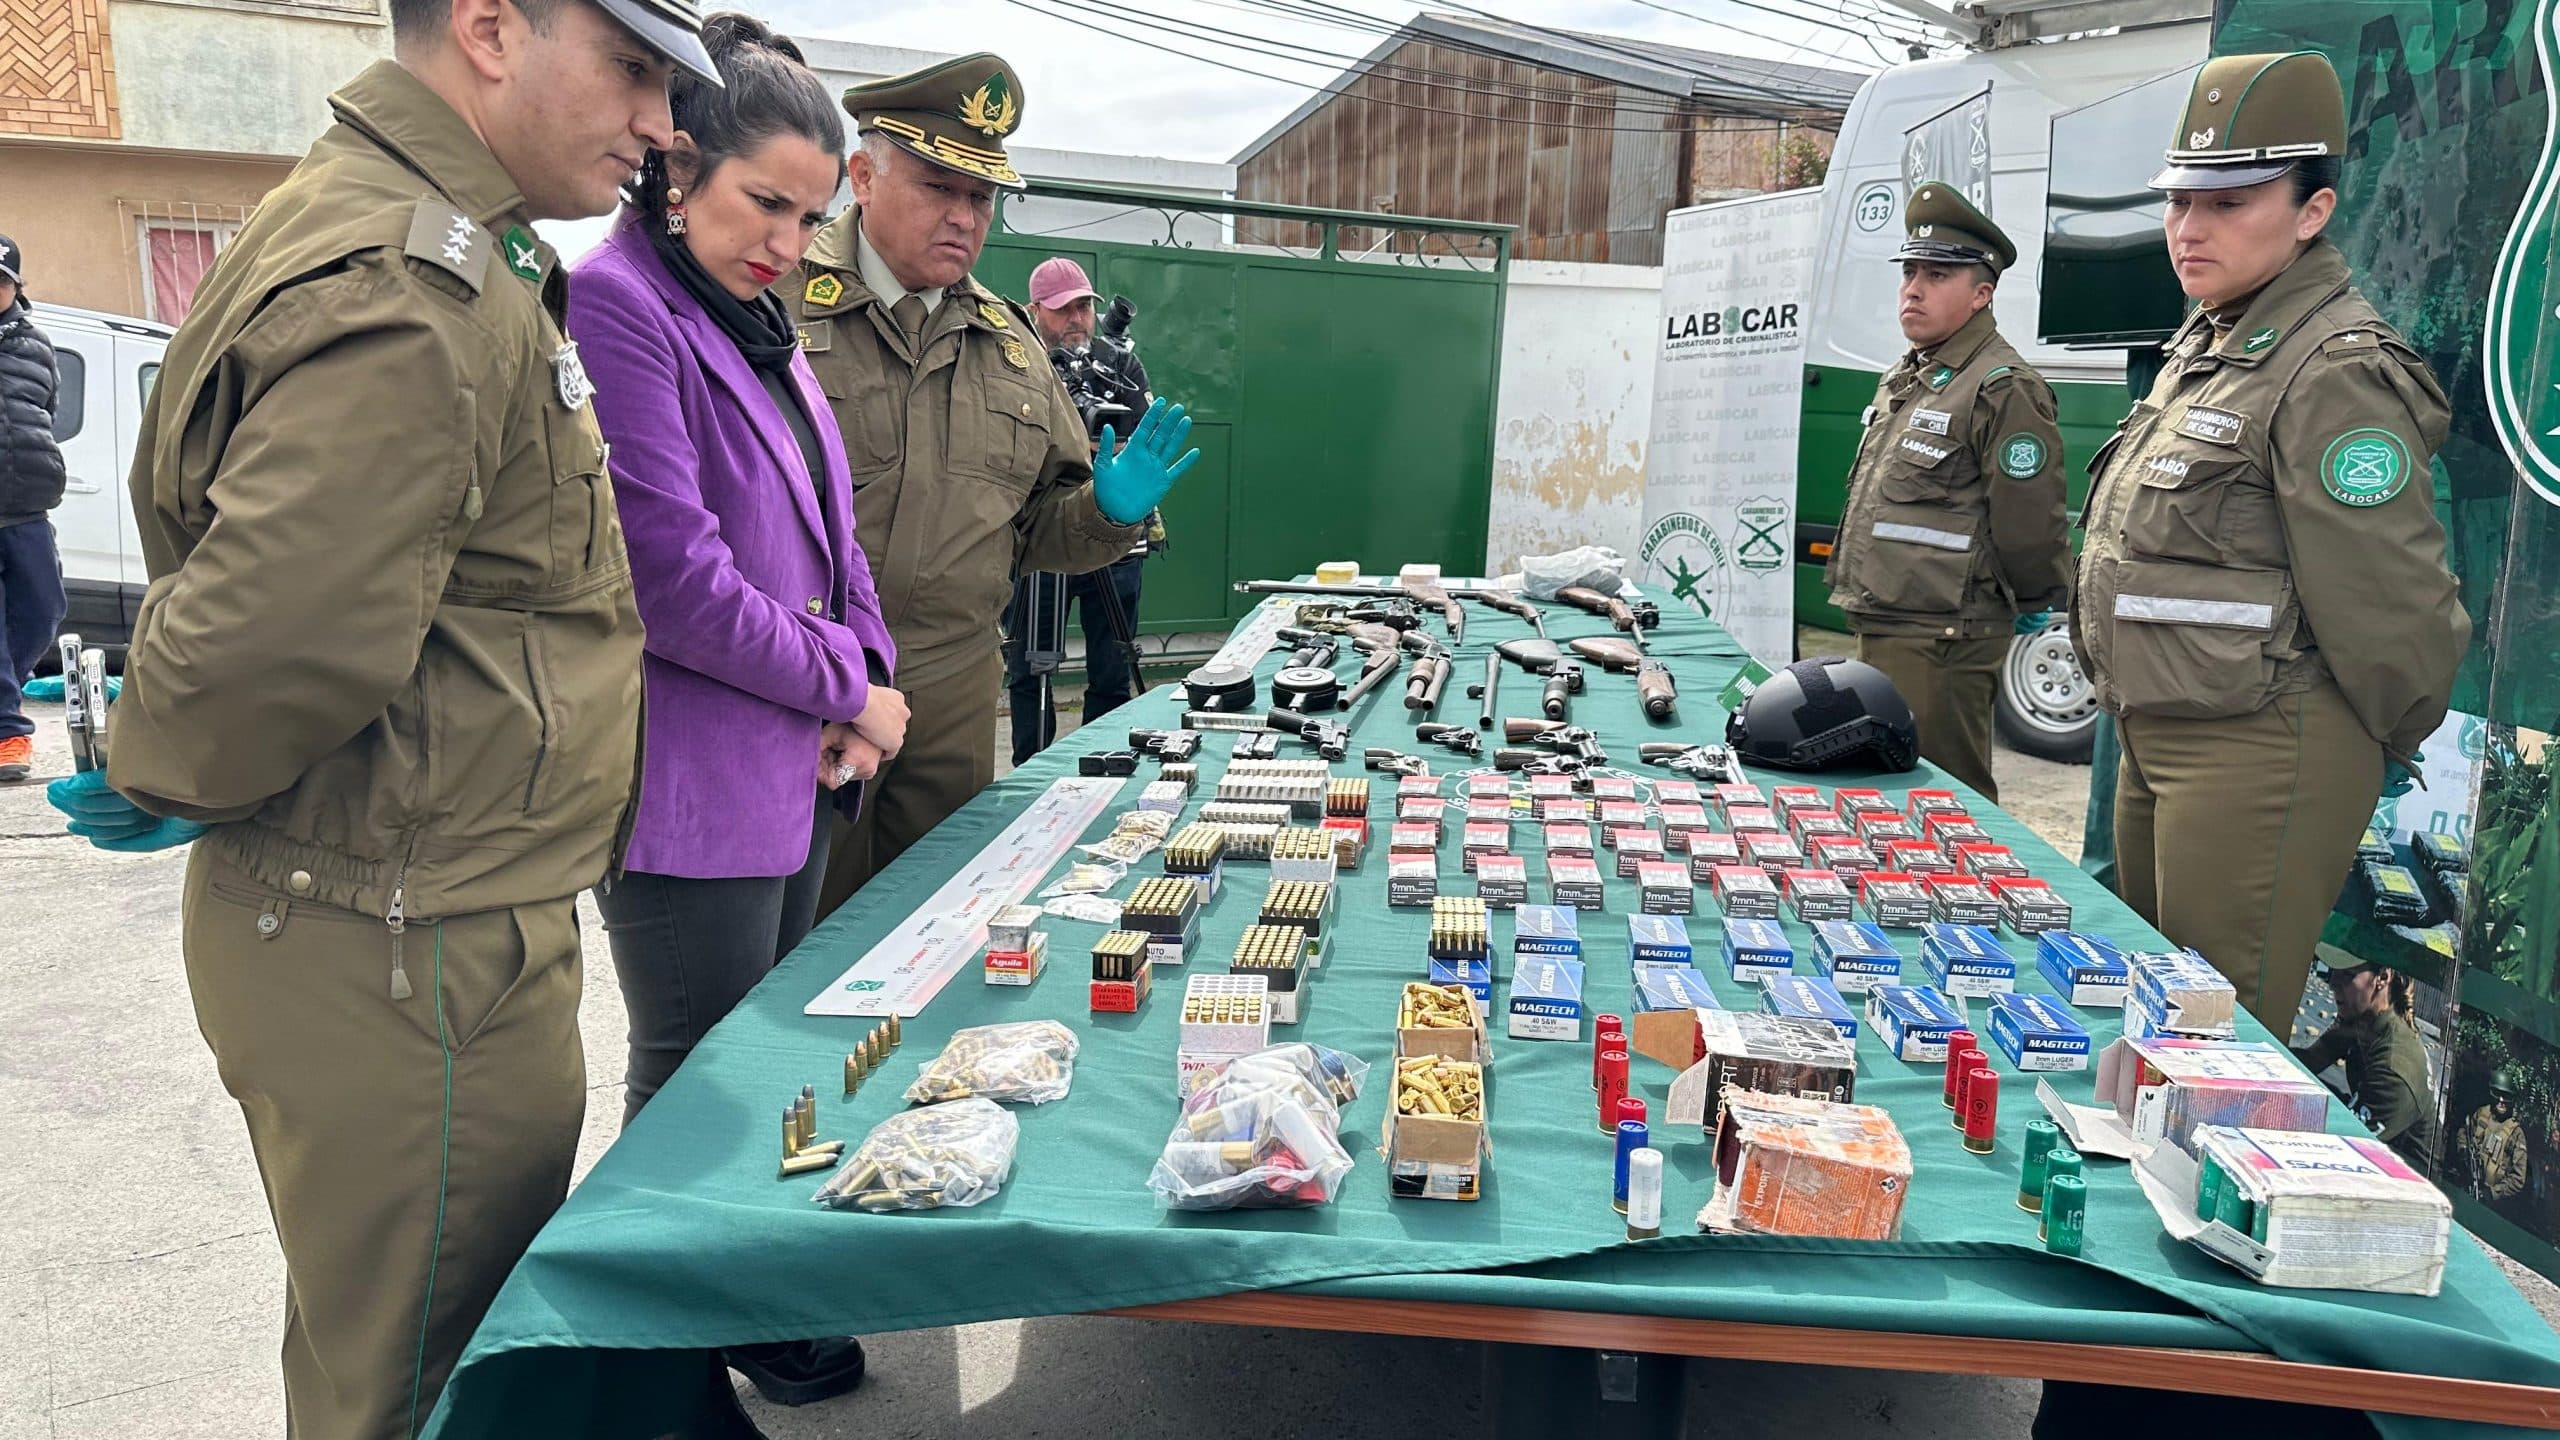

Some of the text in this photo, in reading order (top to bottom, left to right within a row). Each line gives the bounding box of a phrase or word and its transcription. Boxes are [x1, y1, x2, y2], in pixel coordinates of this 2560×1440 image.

[1860, 206, 1889, 221] 133
[1666, 339, 1720, 350] LABORATORIO
[1723, 337, 1734, 345] DE
[2187, 408, 2240, 430] CARABINEROS
[2196, 422, 2221, 437] CHILE
[1902, 438, 1947, 459] LABOCAR
[2334, 487, 2391, 503] LABOCAR
[1641, 515, 1701, 562] CARABINEROS
[1709, 536, 1725, 568] CHILE
[1758, 861, 1782, 869] 9mm
[1833, 865, 1856, 873] 9mm
[1391, 883, 1415, 892] 9mm
[1481, 886, 1504, 895] 9mm
[1557, 888, 1581, 898] 9mm
[1645, 891, 1669, 901] 9mm
[1732, 896, 1755, 905] 9mm
[1804, 901, 1828, 910] 9mm
[1882, 904, 1907, 914] 9mm
[1951, 907, 1976, 916] 9mm
[2022, 910, 2047, 920] 9mm
[1518, 943, 1573, 953] MAGTECH
[1639, 949, 1688, 959] MAGTECH
[1739, 953, 1790, 964] MAGTECH
[991, 958, 1023, 967] Aguila
[1838, 961, 1897, 974] MAGTECH
[1951, 964, 2011, 976] MAGTECH
[1514, 1003, 1575, 1016] MAGTECH
[2028, 1039, 2085, 1050] MAGTECH
[2260, 1138, 2342, 1151] SPORTING
[2285, 1159, 2380, 1175] SAGA
[1754, 1169, 1771, 1206] EXPORT
